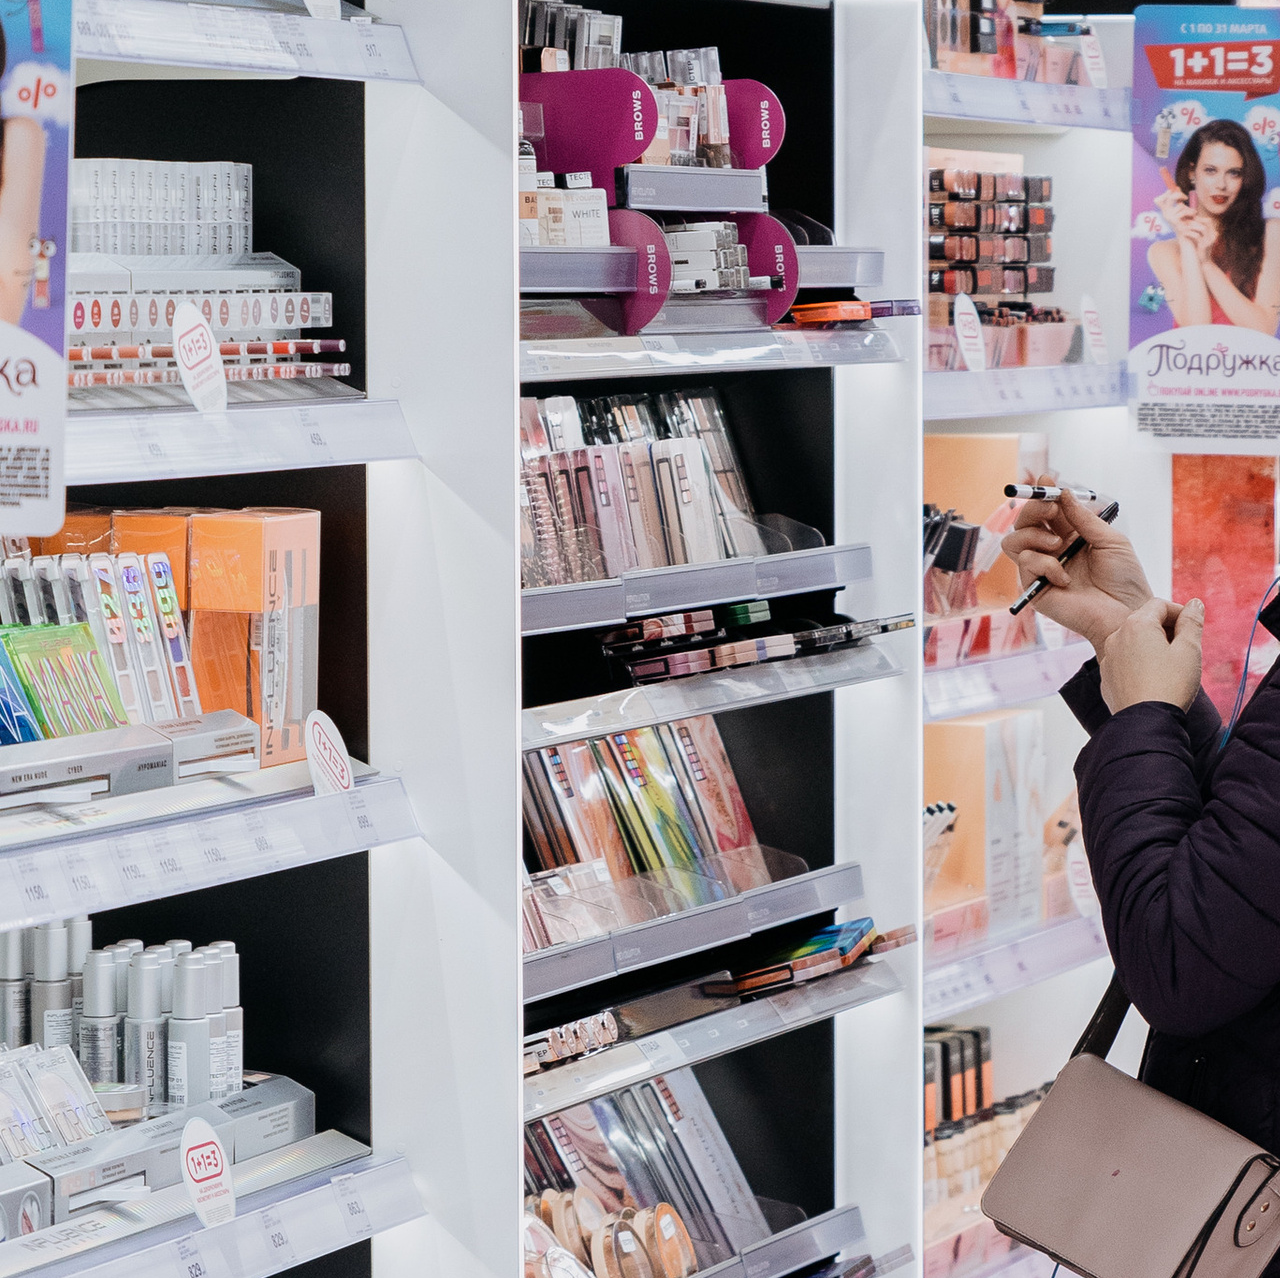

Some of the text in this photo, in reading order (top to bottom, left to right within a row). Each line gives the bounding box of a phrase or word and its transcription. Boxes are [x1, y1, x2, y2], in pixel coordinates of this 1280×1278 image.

[1198, 24, 1213, 33] ПО
[1215, 24, 1228, 33] 31
[1229, 24, 1267, 34] МАРТА
[1169, 45, 1274, 78] 1+1=3
[632, 89, 644, 141] BROWS
[761, 99, 771, 148] BROWS
[572, 208, 600, 219] WHITE
[646, 244, 658, 295] BROWS
[182, 333, 209, 361] 1+1=3
[314, 728, 347, 782] 1+1=3
[67, 764, 84, 775] CYBER
[137, 759, 167, 772] HYPOMANIAC
[11, 770, 48, 784] NEW ERA NUDE
[203, 846, 221, 864] 1150
[122, 863, 140, 881] 1150
[159, 857, 178, 875] 1150
[72, 874, 91, 892] 1150
[25, 883, 45, 902] 1150
[147, 1030, 156, 1105] NFLUENCE
[190, 1150, 220, 1174] 1+1=3
[19, 1219, 108, 1253] INFLUENCE
[271, 1231, 285, 1249] 829
